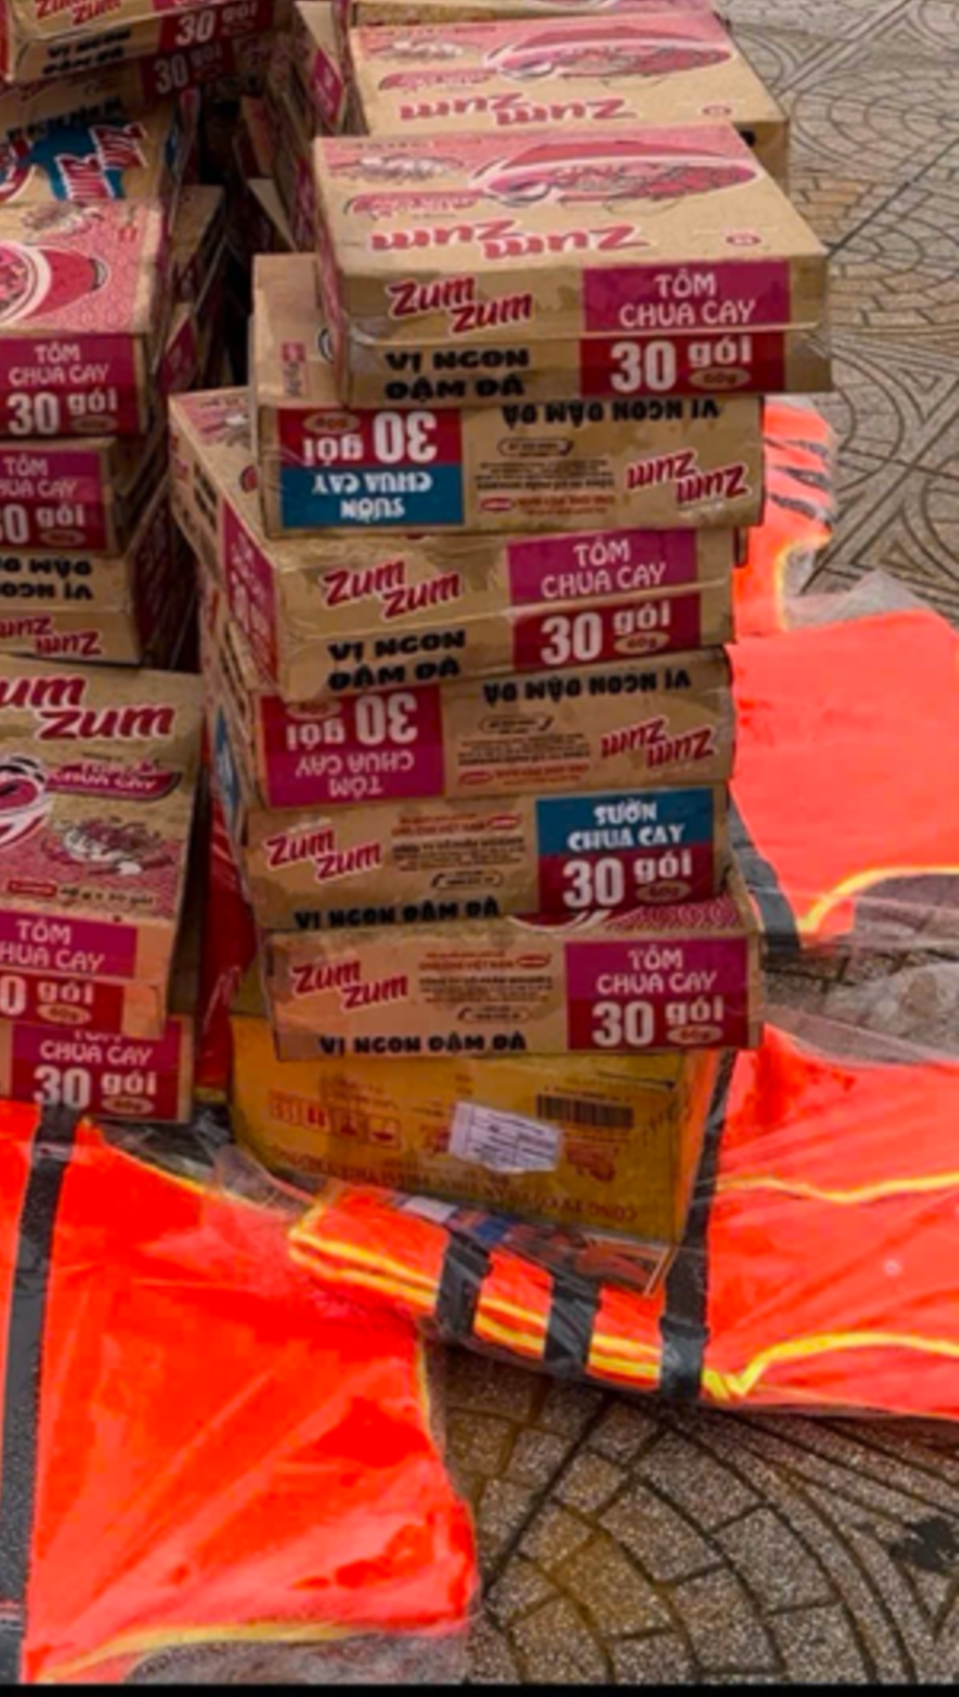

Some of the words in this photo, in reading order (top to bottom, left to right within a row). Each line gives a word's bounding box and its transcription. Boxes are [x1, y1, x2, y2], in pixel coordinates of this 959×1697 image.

[175, 10, 215, 45] 30
[154, 56, 188, 94] 30
[656, 270, 716, 298] TÔM
[620, 303, 696, 327] CHUA
[701, 300, 756, 325] CAY
[34, 341, 81, 364] TÔM
[385, 352, 422, 373] VỊ
[432, 348, 530, 370] NGON
[609, 340, 676, 392] 30
[688, 335, 753, 368] gói
[8, 366, 65, 386] CHUA
[69, 363, 110, 384] CAY
[386, 379, 466, 402] ĐẬM
[476, 374, 525, 397] ĐÀ
[7, 391, 60, 435] 30
[67, 386, 117, 416] gói
[304, 433, 363, 466] gói
[373, 411, 437, 463] 30
[3, 453, 48, 477] TÔM
[37, 479, 77, 498] CAY
[312, 472, 360, 495] CAY
[364, 472, 433, 493] CHUA
[35, 503, 85, 528] gói
[573, 536, 630, 567] TÔM
[542, 570, 612, 598] CHUA
[617, 562, 666, 589] CAY
[541, 612, 603, 665] 30
[613, 600, 670, 636] gói
[328, 642, 363, 663] VỊ
[375, 630, 465, 657] NGON
[589, 673, 658, 696] NGON
[356, 693, 418, 745] 30
[287, 718, 345, 751] gói
[295, 755, 343, 778] CAY
[348, 751, 414, 774] CHUA
[329, 775, 383, 799] TÔM
[593, 797, 657, 826] SƯỜN
[567, 829, 634, 852] CHUA
[638, 823, 685, 846] CAY
[562, 858, 625, 908] 30
[634, 849, 692, 885] gói
[329, 907, 395, 927] NGON
[16, 918, 71, 946] TÔM
[55, 950, 106, 973] CAY
[628, 944, 683, 971] TÔM
[37, 977, 94, 1004] gói
[597, 972, 664, 995] CHUA
[669, 971, 718, 993] CAY
[592, 1000, 655, 1047] 30
[665, 995, 724, 1026] gói
[39, 1040, 103, 1064] CHUA
[107, 1046, 153, 1066] CAY
[354, 1036, 421, 1053] NGON
[33, 1065, 92, 1110] 30
[101, 1071, 157, 1096] gói
